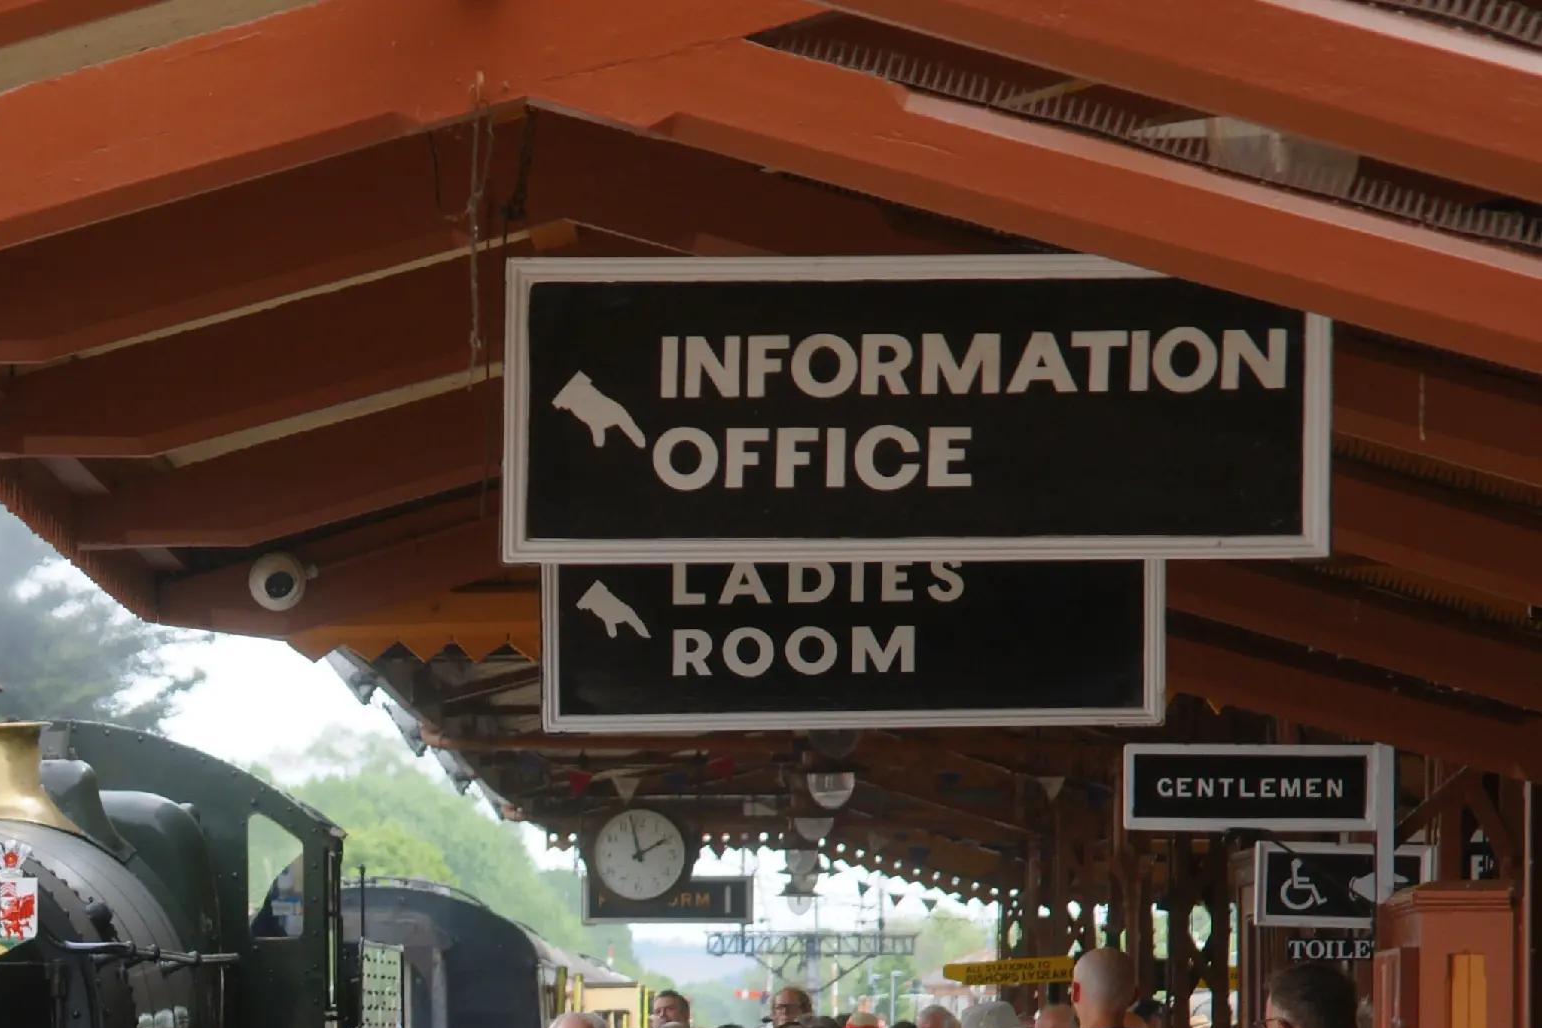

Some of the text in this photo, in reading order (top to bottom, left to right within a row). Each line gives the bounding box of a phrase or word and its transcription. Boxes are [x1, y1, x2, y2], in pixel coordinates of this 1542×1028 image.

[660, 326, 1288, 399] INFORMATION
[652, 424, 973, 491] OFFICE
[671, 561, 965, 605] LADIES
[671, 625, 916, 678] ROOM
[1156, 777, 1344, 798] GENTLEMEN
